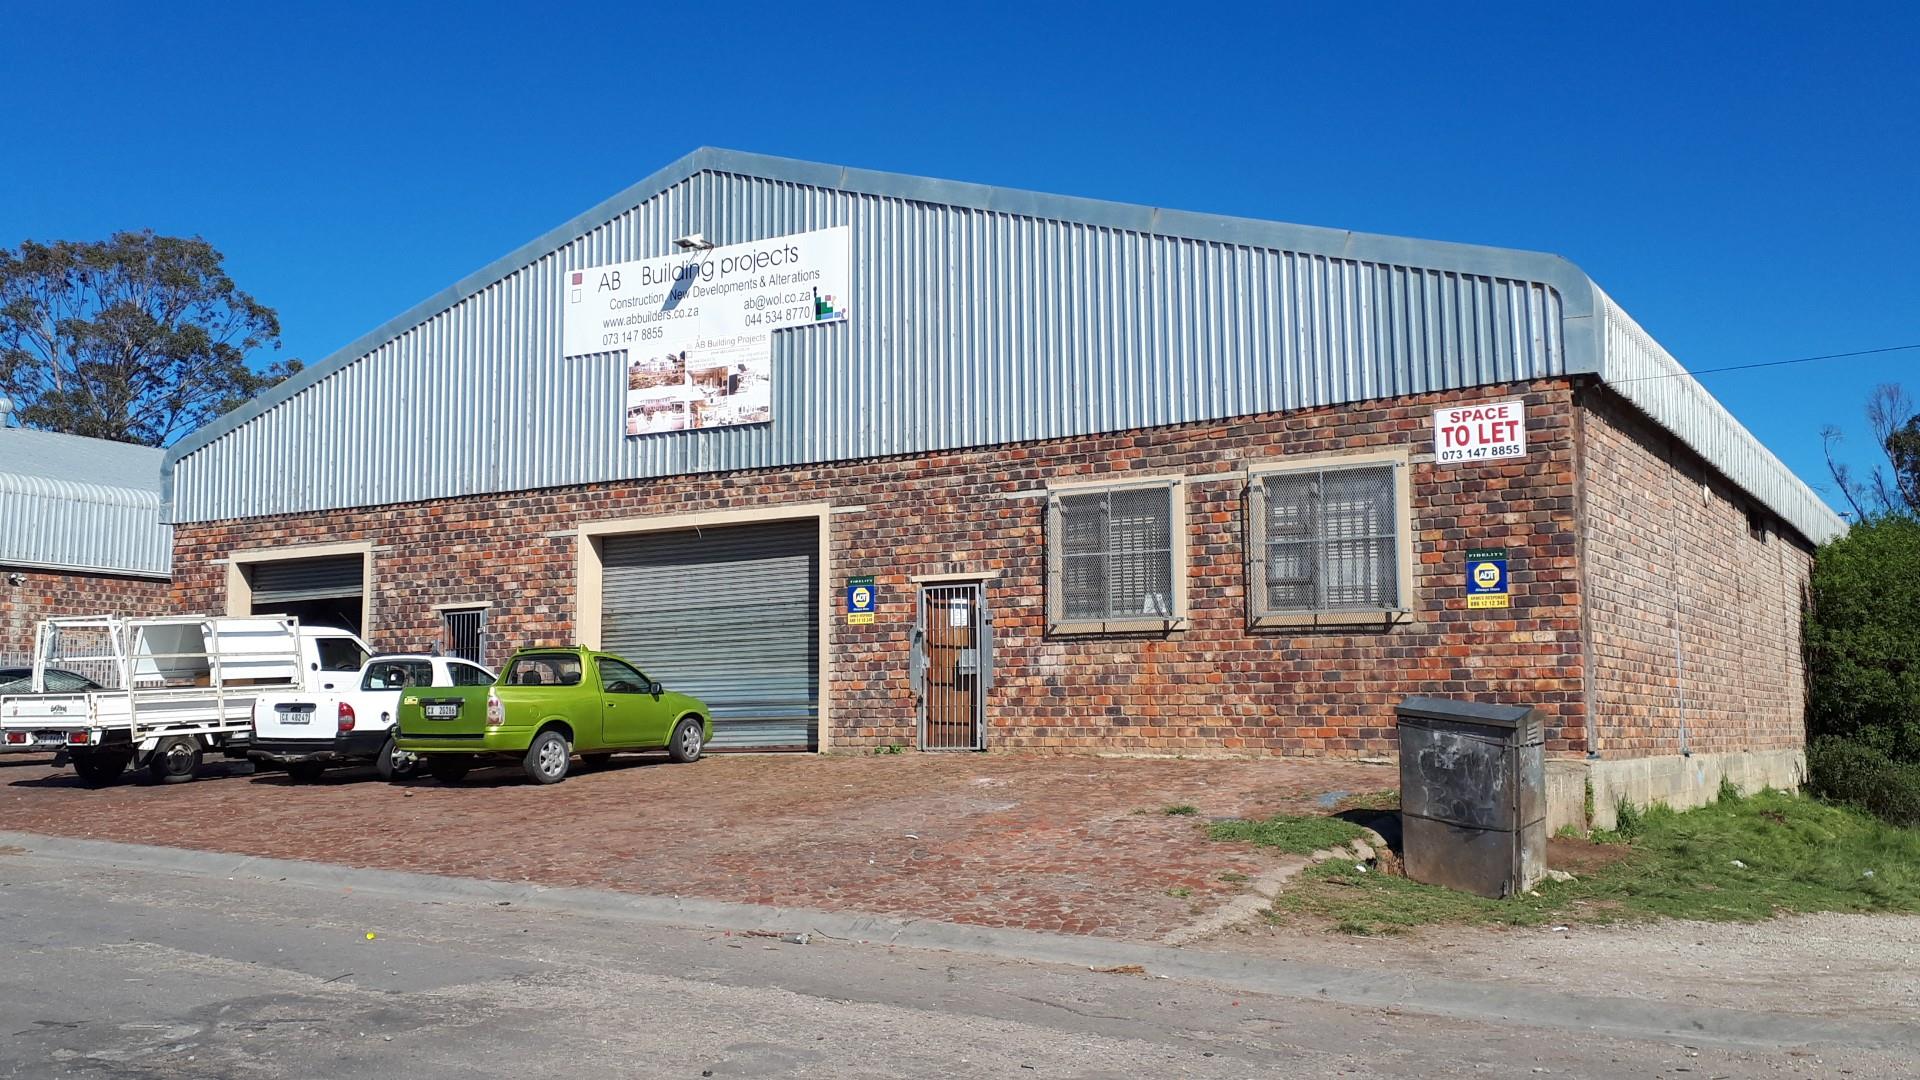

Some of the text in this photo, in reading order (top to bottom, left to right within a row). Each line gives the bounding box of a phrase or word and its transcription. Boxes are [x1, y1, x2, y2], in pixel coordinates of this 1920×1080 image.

[598, 243, 799, 292] AB Building projects
[609, 269, 820, 310] Construction New Developments & Alterations
[744, 291, 811, 310] ab@wol.co.za
[602, 307, 699, 329] www.abbuilders.co.za
[745, 306, 810, 327] 044 534 8770
[602, 326, 663, 346] 073 147 8855
[695, 334, 766, 349] AB Building Projects
[1450, 407, 1509, 423] SPACE
[1441, 420, 1519, 448] TO LET
[1442, 445, 1520, 460] 073 147 8855
[1479, 570, 1495, 580] ADT
[856, 593, 866, 601] ADT
